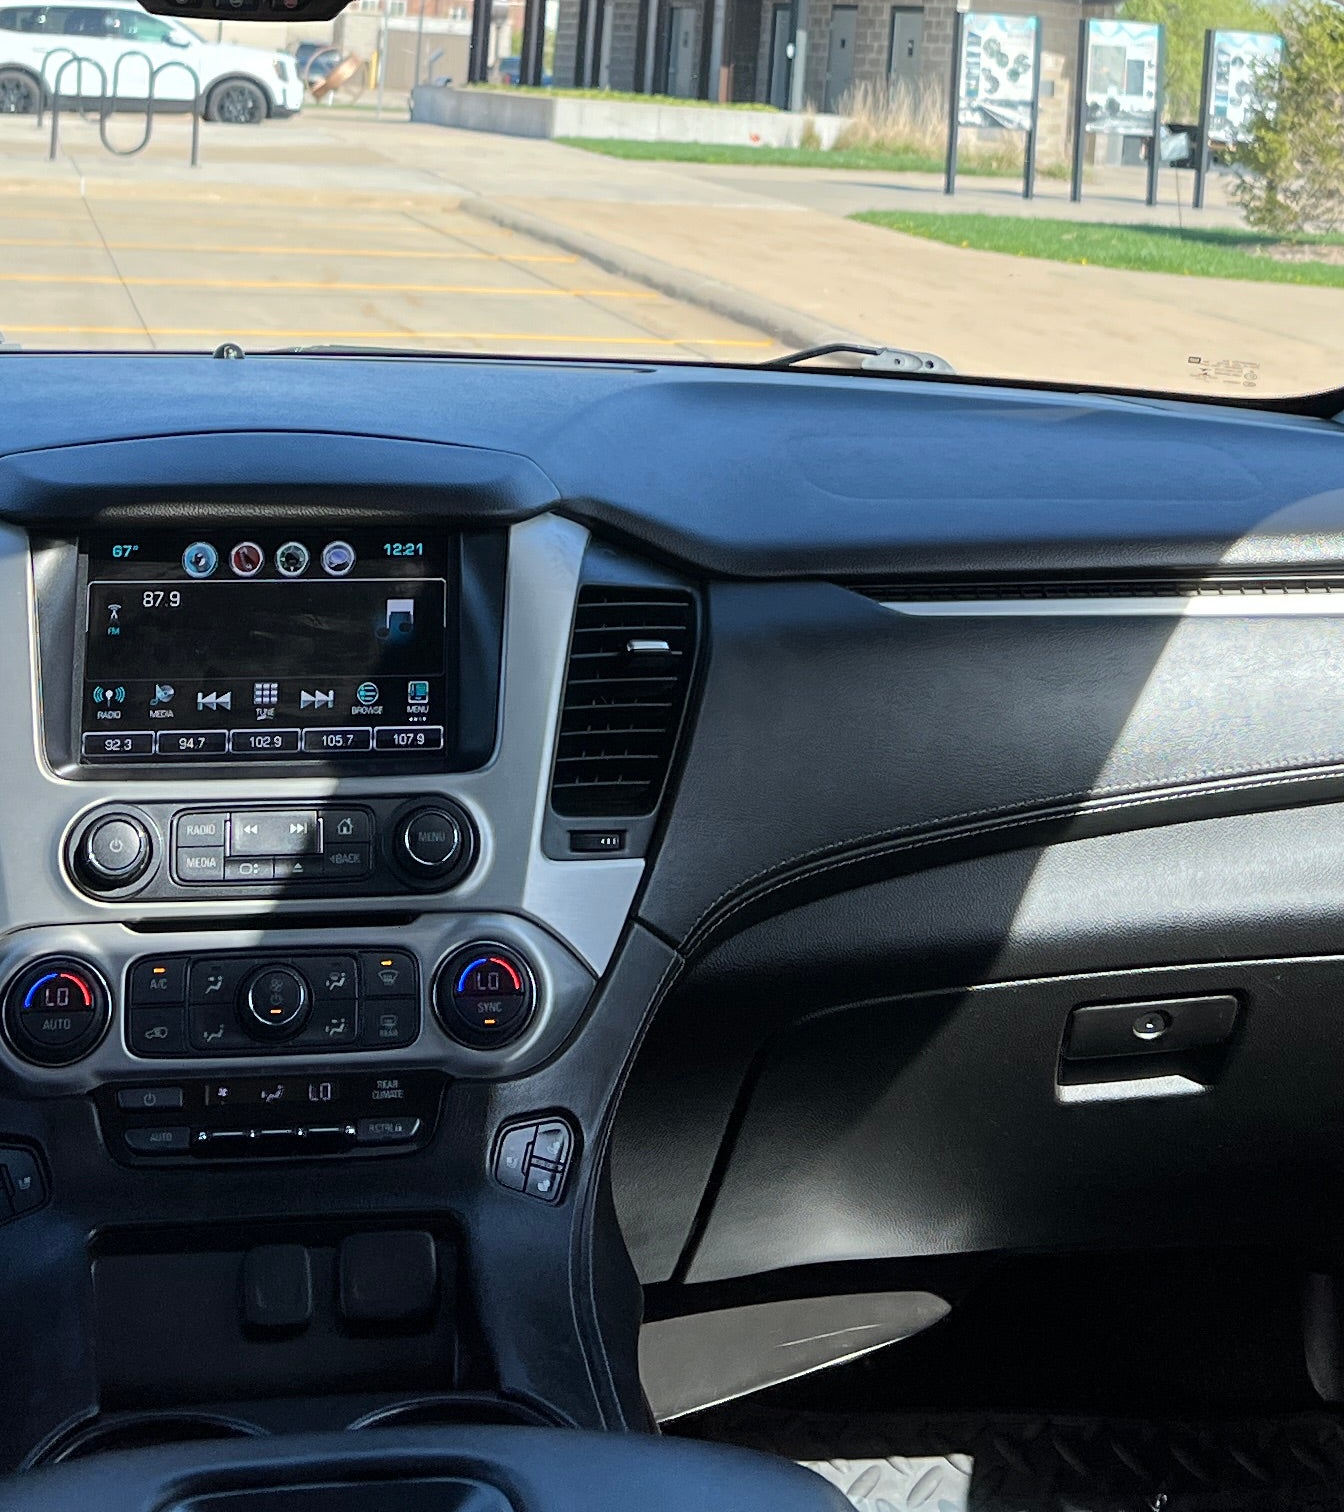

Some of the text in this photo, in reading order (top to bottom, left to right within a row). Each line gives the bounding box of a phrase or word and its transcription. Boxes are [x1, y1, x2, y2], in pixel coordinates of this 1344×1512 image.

[383, 542, 424, 556] 12:21
[142, 590, 181, 608] 87.9
[107, 626, 120, 636] FM
[96, 710, 122, 720] RADIO
[149, 709, 175, 719] MEDIA
[351, 705, 384, 715] BROWSE
[406, 705, 429, 714] MENU
[104, 739, 133, 751] 92.3
[178, 737, 206, 750] 94.7
[249, 735, 283, 748] 102.9
[322, 734, 355, 747] 105.7
[393, 733, 426, 746] 107.9
[186, 824, 216, 836] RADIO
[418, 831, 446, 843] MENU
[186, 857, 217, 868] MEDIA
[149, 978, 168, 990] A/C
[477, 1001, 503, 1013] SYNC
[42, 1018, 71, 1031] AUTO
[376, 1079, 399, 1089] REAR
[371, 1089, 404, 1100] CLIMATE
[149, 1131, 173, 1142] AUTO
